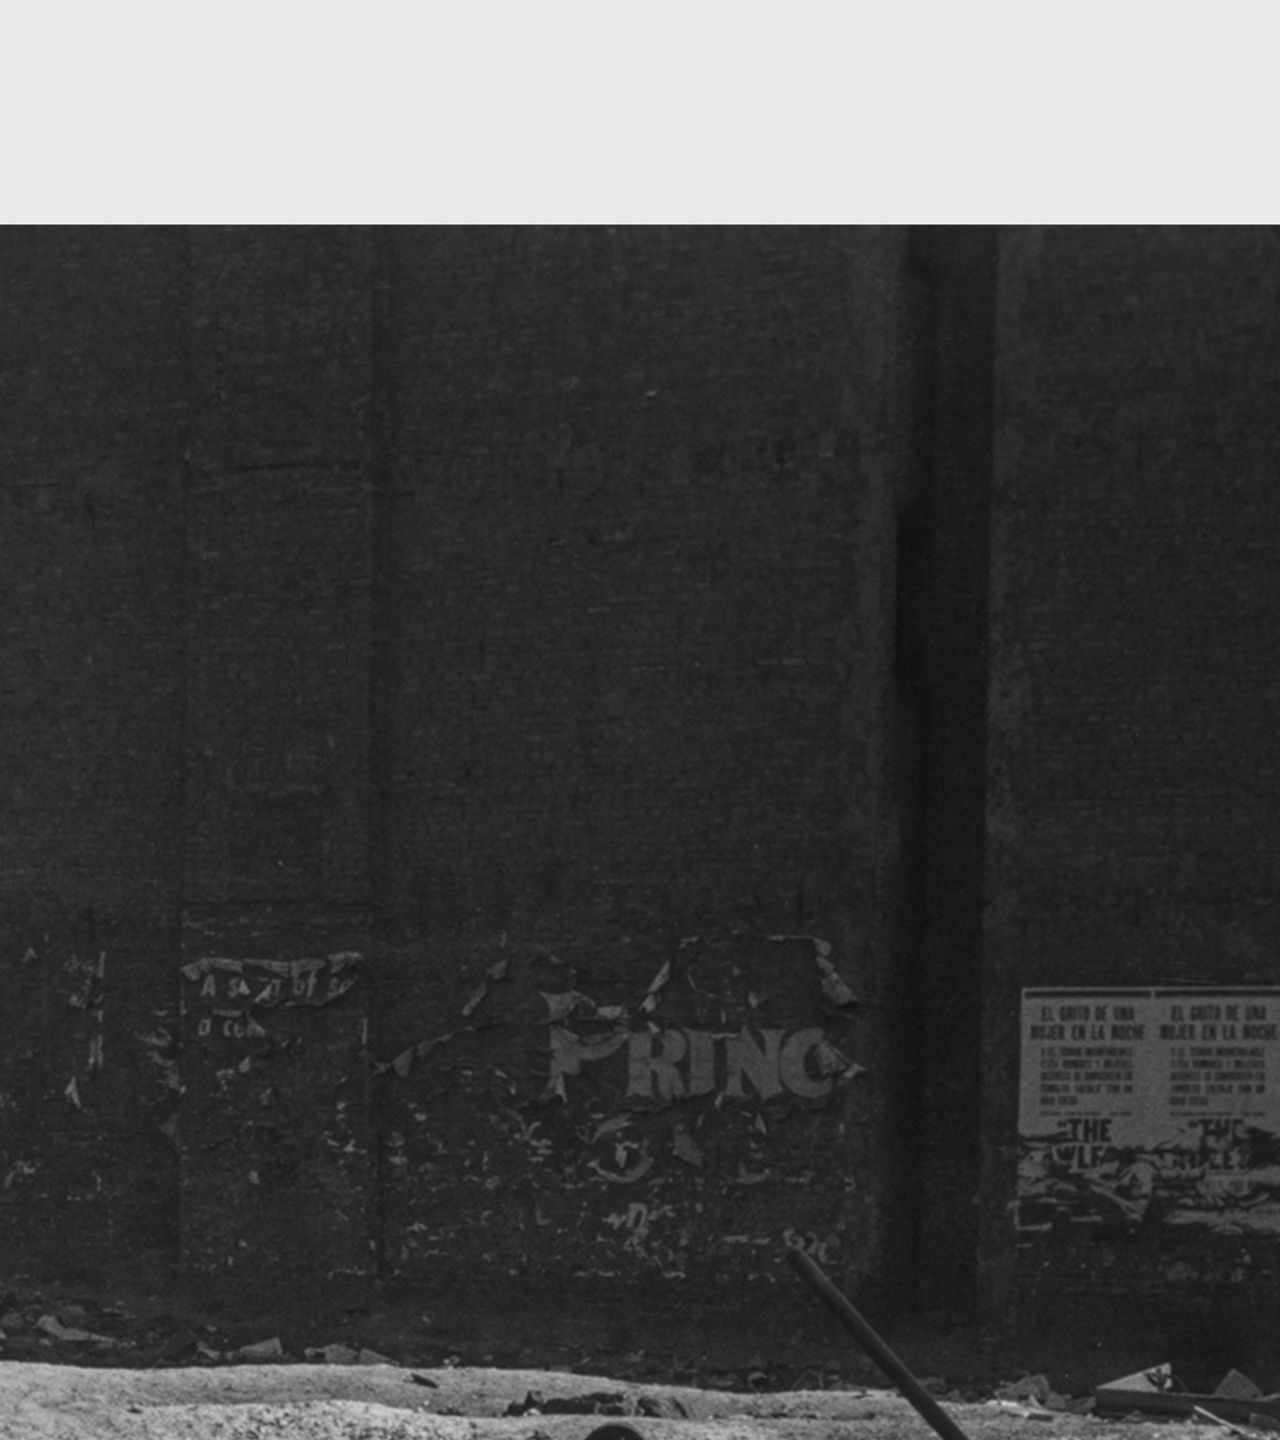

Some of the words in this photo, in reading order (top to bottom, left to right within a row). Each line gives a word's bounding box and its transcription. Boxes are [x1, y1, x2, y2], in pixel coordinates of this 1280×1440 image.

[1041, 1005, 1055, 1022] EL
[1059, 1005, 1090, 1022] GRITO
[1094, 1005, 1108, 1022] DE
[1113, 1005, 1135, 1022] UNA
[1170, 1004, 1184, 1022] EL
[1189, 1004, 1222, 1022] GRITO
[1225, 1004, 1239, 1022] DE
[1244, 1004, 1267, 1022] UNA
[1029, 1024, 1066, 1041] MUJER
[1071, 1024, 1086, 1041] EN
[1091, 1024, 1105, 1041] LA
[1110, 1024, 1146, 1041] NOCHE
[1159, 1024, 1197, 1041] MUJER
[1201, 1024, 1217, 1041] EN
[1222, 1024, 1237, 1041] LA
[1242, 1023, 1278, 1041] NOCHE
